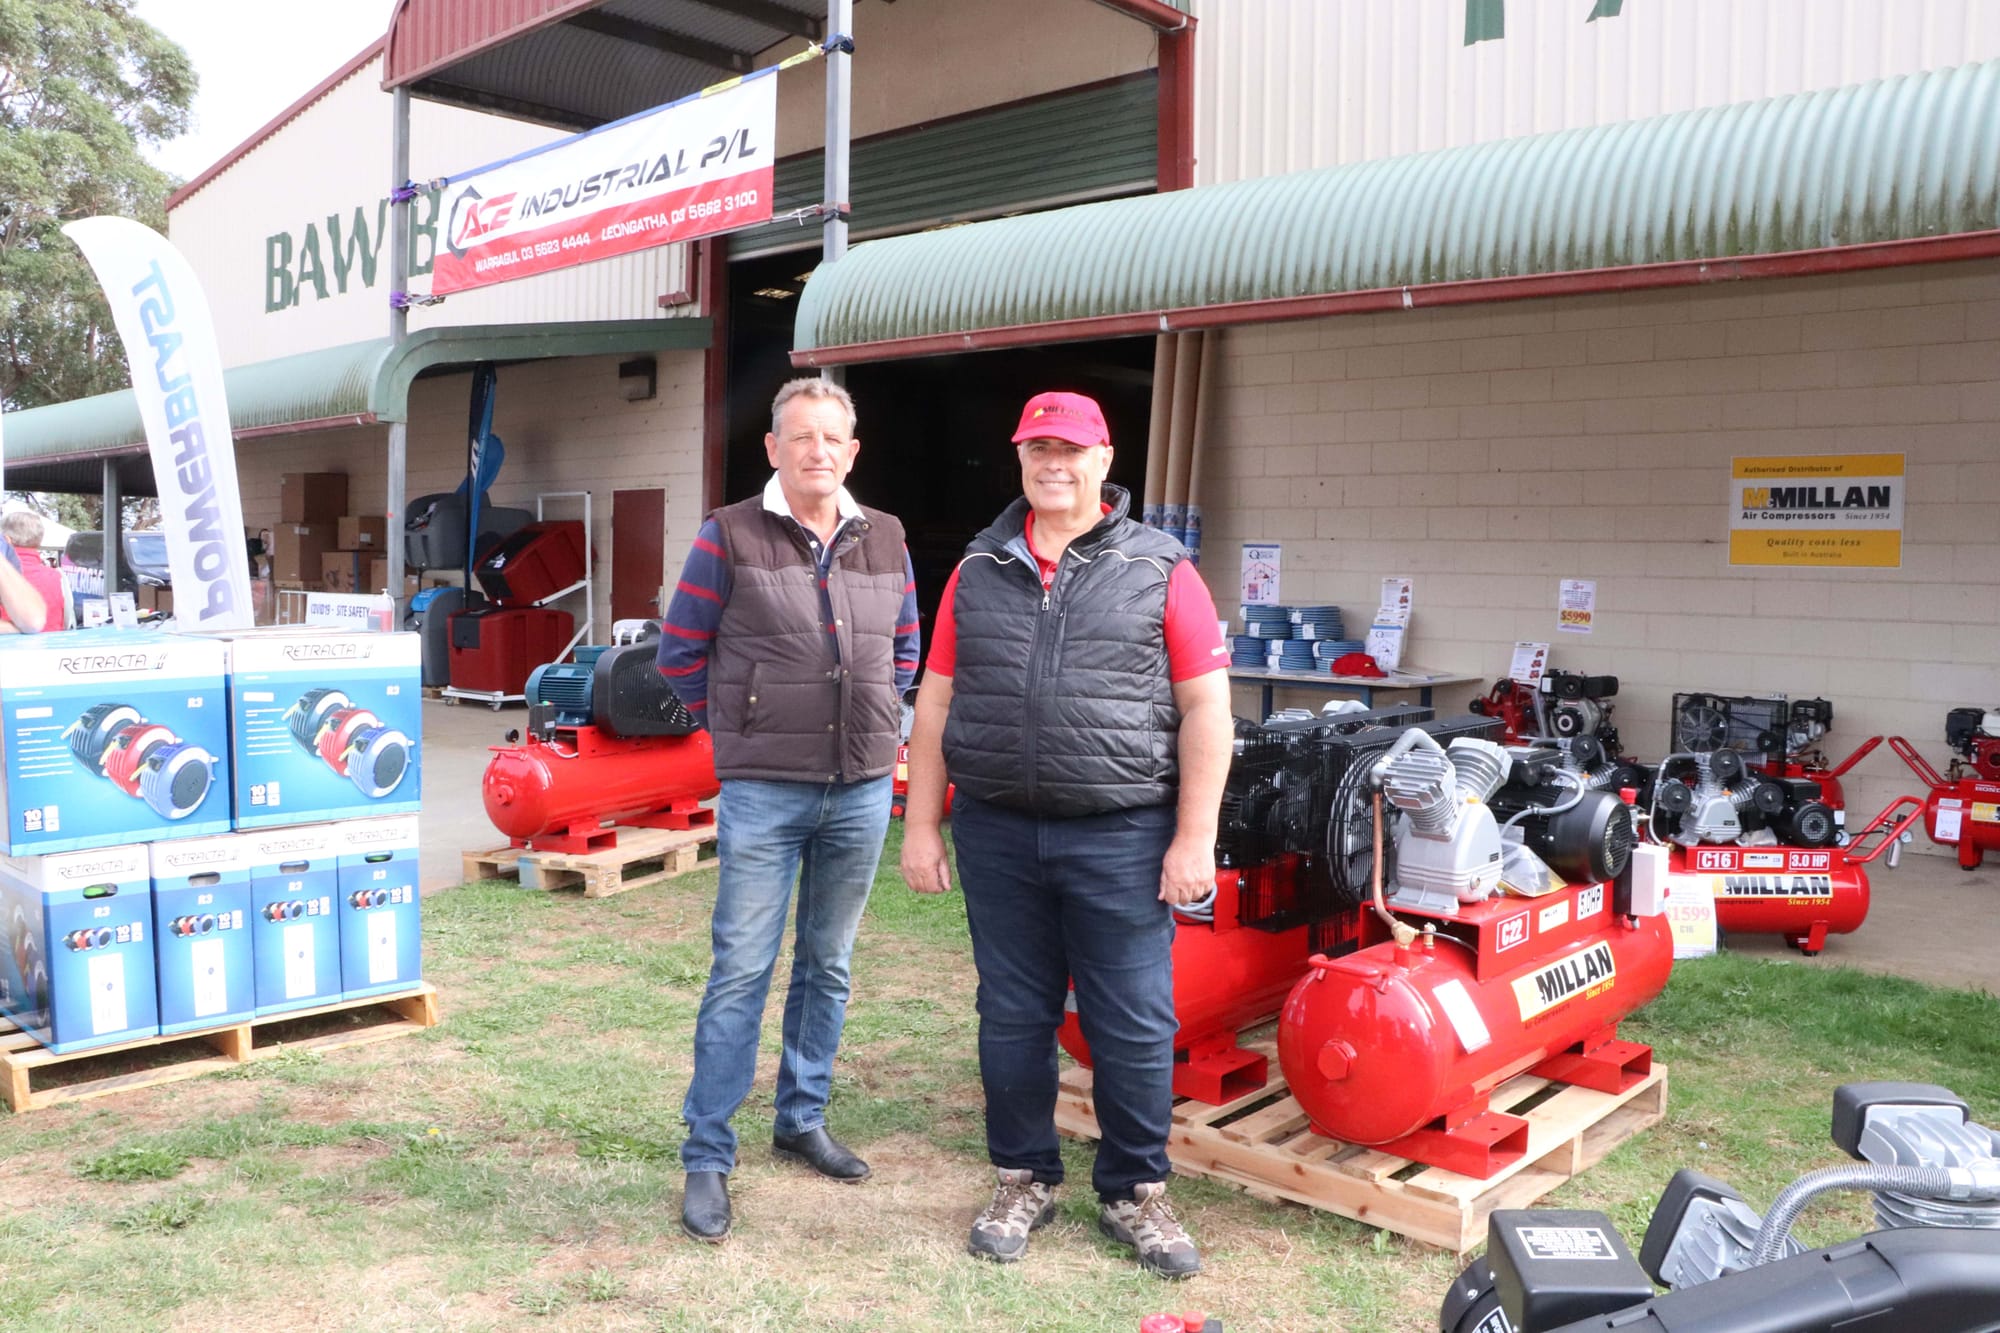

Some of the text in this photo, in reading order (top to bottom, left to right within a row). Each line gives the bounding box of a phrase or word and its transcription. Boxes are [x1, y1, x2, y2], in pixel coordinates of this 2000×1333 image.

[519, 149, 690, 220] INDUSTRIAL
[700, 128, 758, 168] P/L
[475, 246, 521, 272] WARRAGUL
[521, 244, 534, 260] 03
[535, 239, 560, 257] 5623
[561, 231, 591, 250] 4444
[601, 215, 669, 241] LEONGATHA
[671, 208, 686, 224] 03
[724, 189, 758, 212] 3100
[265, 186, 441, 314] BAW B
[1742, 486, 1891, 509] McMILLAN
[1742, 511, 1890, 521] Air Compressors Since 1954
[1767, 537, 1861, 547] Quality costs less
[336, 604, 347, 617] SITE
[348, 605, 370, 618] SAFETY
[1560, 610, 1592, 623] $5990
[282, 643, 357, 661] RETRACTA
[58, 653, 148, 674] RETRACTA
[24, 809, 42, 822] 10
[165, 849, 227, 867] RETRACTA
[1702, 854, 1731, 867] C16
[1791, 854, 1810, 867] 3.0
[1812, 855, 1828, 867] HP
[57, 858, 124, 879] RETRACTA
[1787, 898, 1810, 906] Since
[1501, 918, 1523, 946] C22
[1586, 986, 1601, 1001] Since
